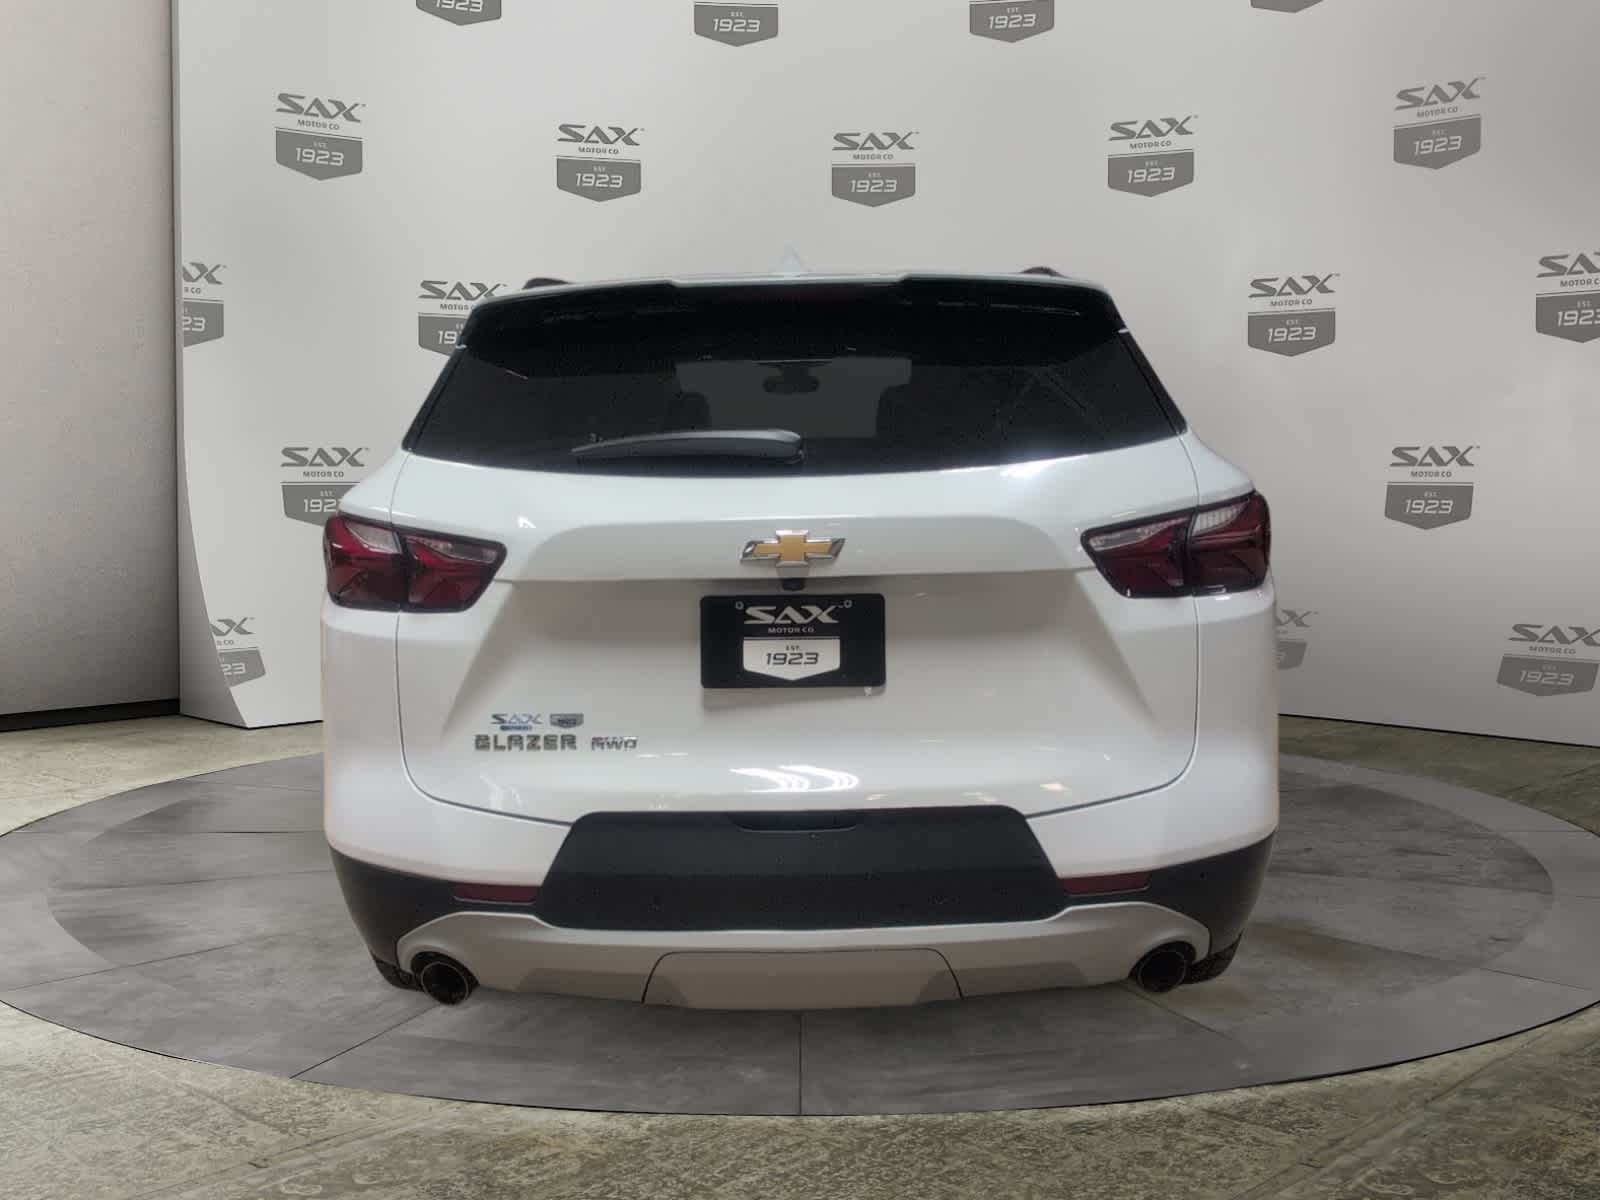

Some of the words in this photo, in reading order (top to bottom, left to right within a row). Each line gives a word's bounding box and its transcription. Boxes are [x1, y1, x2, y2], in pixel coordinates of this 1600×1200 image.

[713, 18, 761, 33] 1923
[989, 13, 1037, 30] 1923
[1394, 78, 1480, 111] SAX
[275, 93, 361, 123] SAX
[557, 124, 640, 146] SAX
[1108, 115, 1193, 141] SAX
[832, 131, 914, 150] SAX
[1413, 135, 1462, 156] 1923
[295, 147, 345, 166] 1923
[575, 173, 623, 188] 1923
[1127, 166, 1175, 184] 1923
[850, 179, 897, 193] 1923
[1536, 252, 1600, 279] SA
[418, 280, 501, 301] SAX
[1248, 273, 1336, 298] SAX
[1560, 278, 1592, 287] MOTOR
[183, 316, 206, 332] 23
[437, 330, 460, 344] 19
[1267, 326, 1317, 344] 1923
[280, 447, 365, 467] SAX
[1389, 446, 1475, 467] SAX
[303, 498, 338, 513] 192
[1405, 499, 1454, 514] 1923
[743, 605, 840, 625] SAX
[767, 626, 800, 634] MOTOR
[1508, 623, 1600, 647] SAX
[766, 652, 819, 665] 1923
[220, 662, 246, 676] 23
[1520, 669, 1575, 686] 1923
[490, 713, 543, 725] SAX
[474, 734, 577, 751] BLAZER
